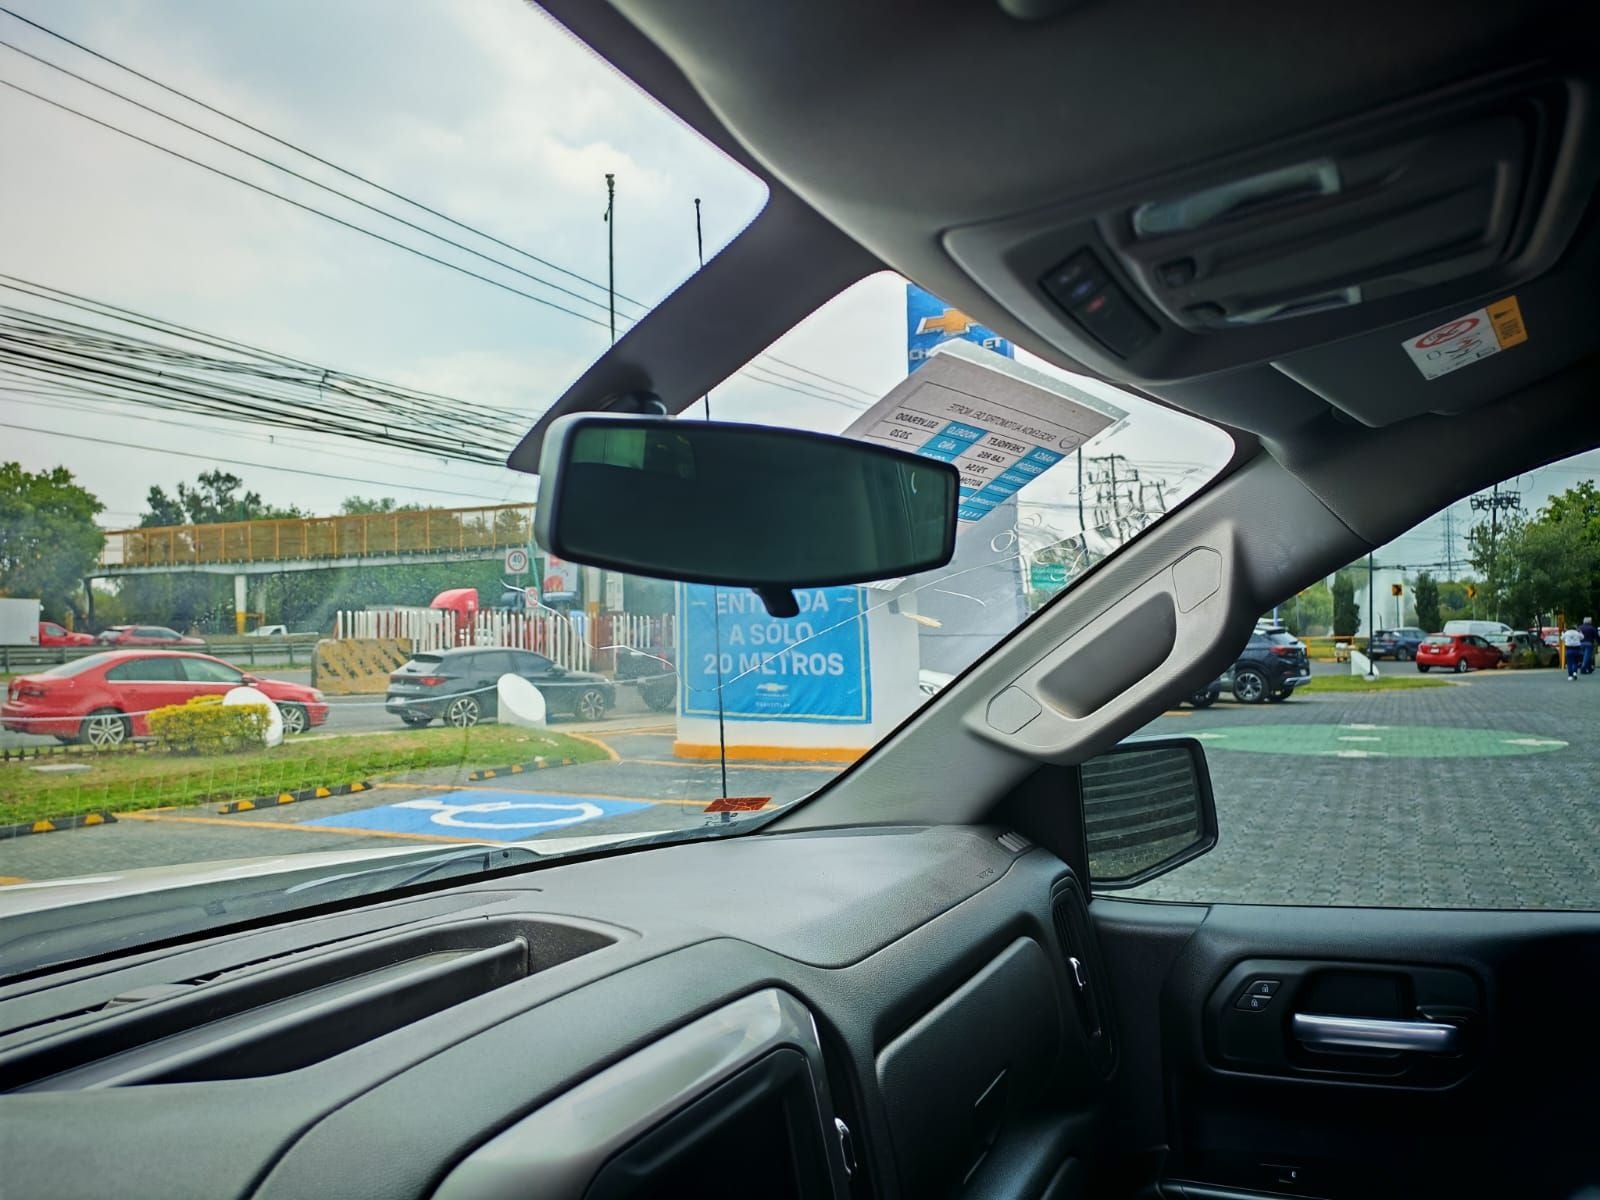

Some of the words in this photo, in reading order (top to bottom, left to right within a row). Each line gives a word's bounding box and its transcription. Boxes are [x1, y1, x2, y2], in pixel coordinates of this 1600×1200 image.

[511, 554, 522, 564] 40
[716, 591, 830, 614] ENTDA
[728, 624, 746, 646] A
[703, 652, 733, 675] 20
[738, 651, 844, 676] METROS
